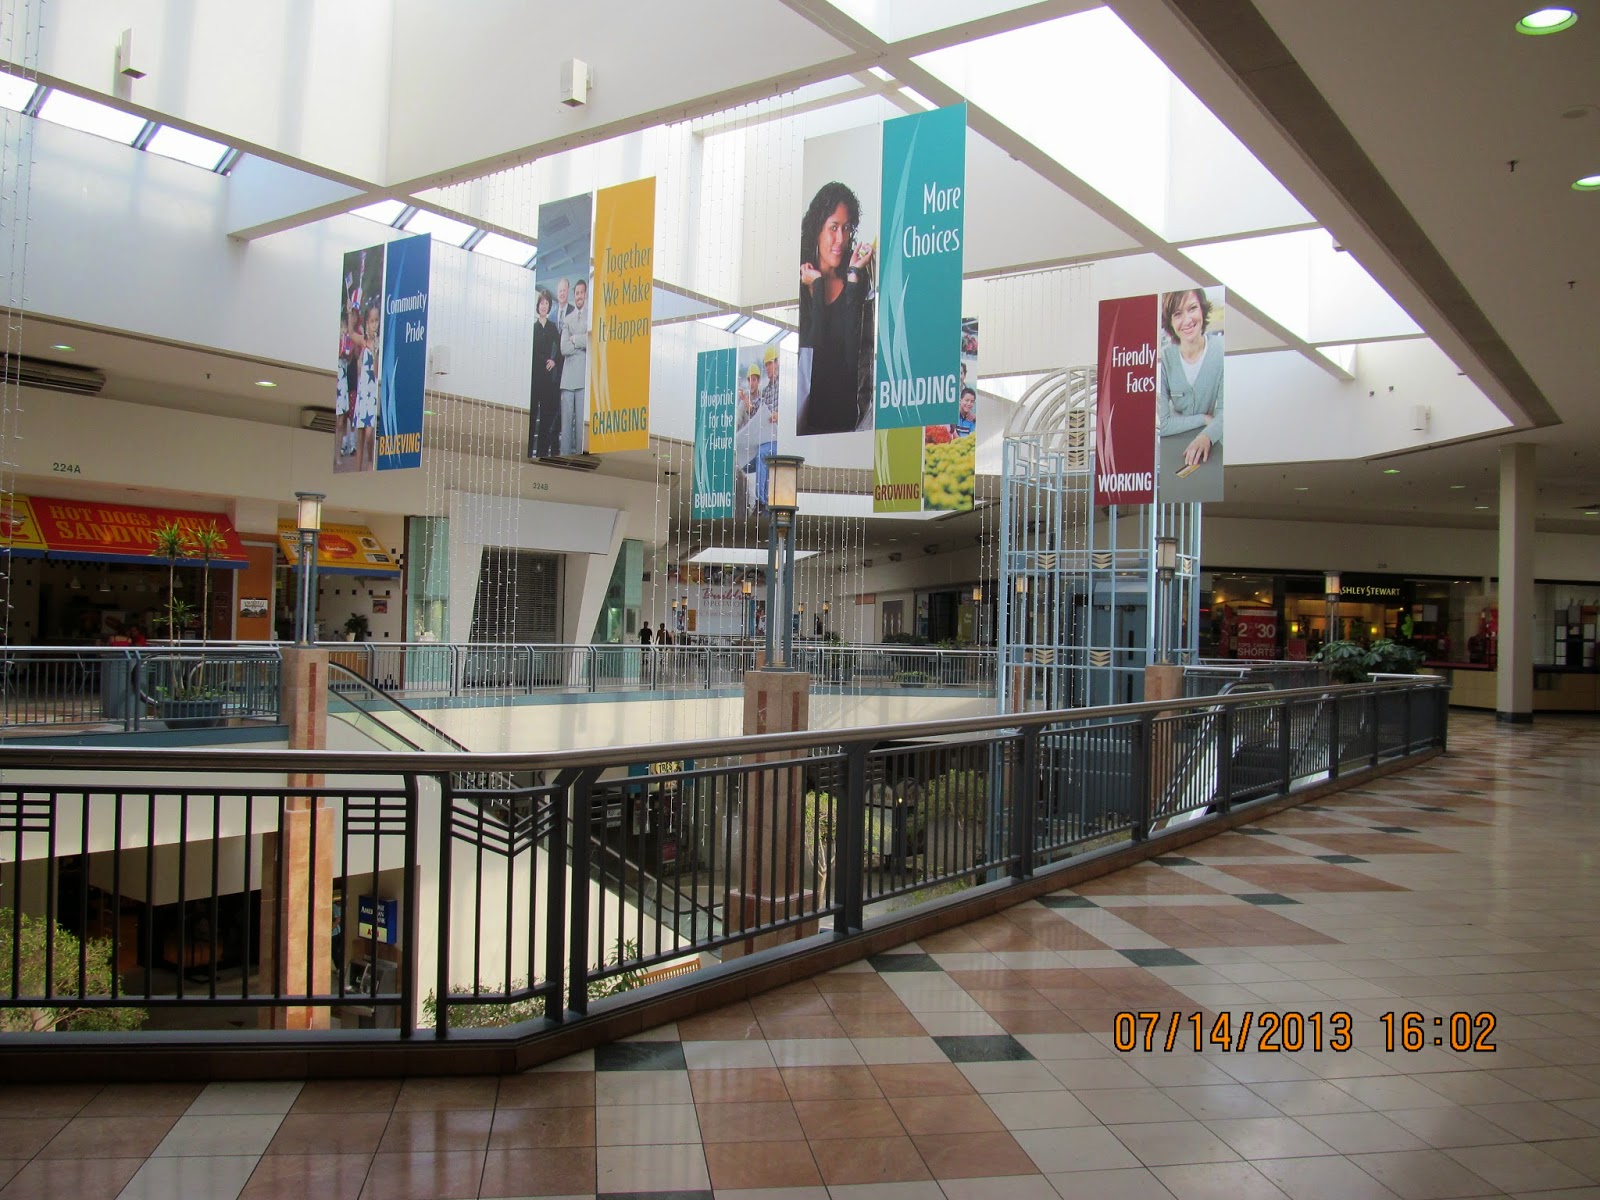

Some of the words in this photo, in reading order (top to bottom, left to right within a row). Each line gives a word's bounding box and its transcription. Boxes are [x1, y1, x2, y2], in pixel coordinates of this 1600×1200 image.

[923, 182, 961, 215] More
[903, 226, 960, 258] Choices
[606, 243, 653, 276] Together
[603, 284, 619, 308] We
[622, 275, 651, 305] Make
[386, 290, 428, 315] Community
[405, 321, 425, 342] Pride
[598, 317, 607, 342] It
[609, 316, 650, 345] Happen
[1112, 343, 1156, 369] Friendly
[879, 374, 957, 409] BUILDING
[1126, 372, 1155, 393] Faces
[700, 390, 734, 410] Blueprint
[592, 406, 647, 436] CHANGING
[709, 411, 719, 429] for
[721, 410, 733, 428] the
[379, 433, 421, 456] BELIEVING
[709, 433, 733, 451] Future
[53, 462, 82, 474] 224A
[874, 483, 920, 502] GROWING
[1098, 472, 1152, 493] WORKING
[694, 491, 732, 509] BUILDING
[49, 505, 92, 522] HOT
[97, 509, 150, 526] DOGS
[57, 521, 229, 550] SANDWHS
[1366, 586, 1400, 596] STEWART
[1237, 647, 1276, 657] SHORTS
